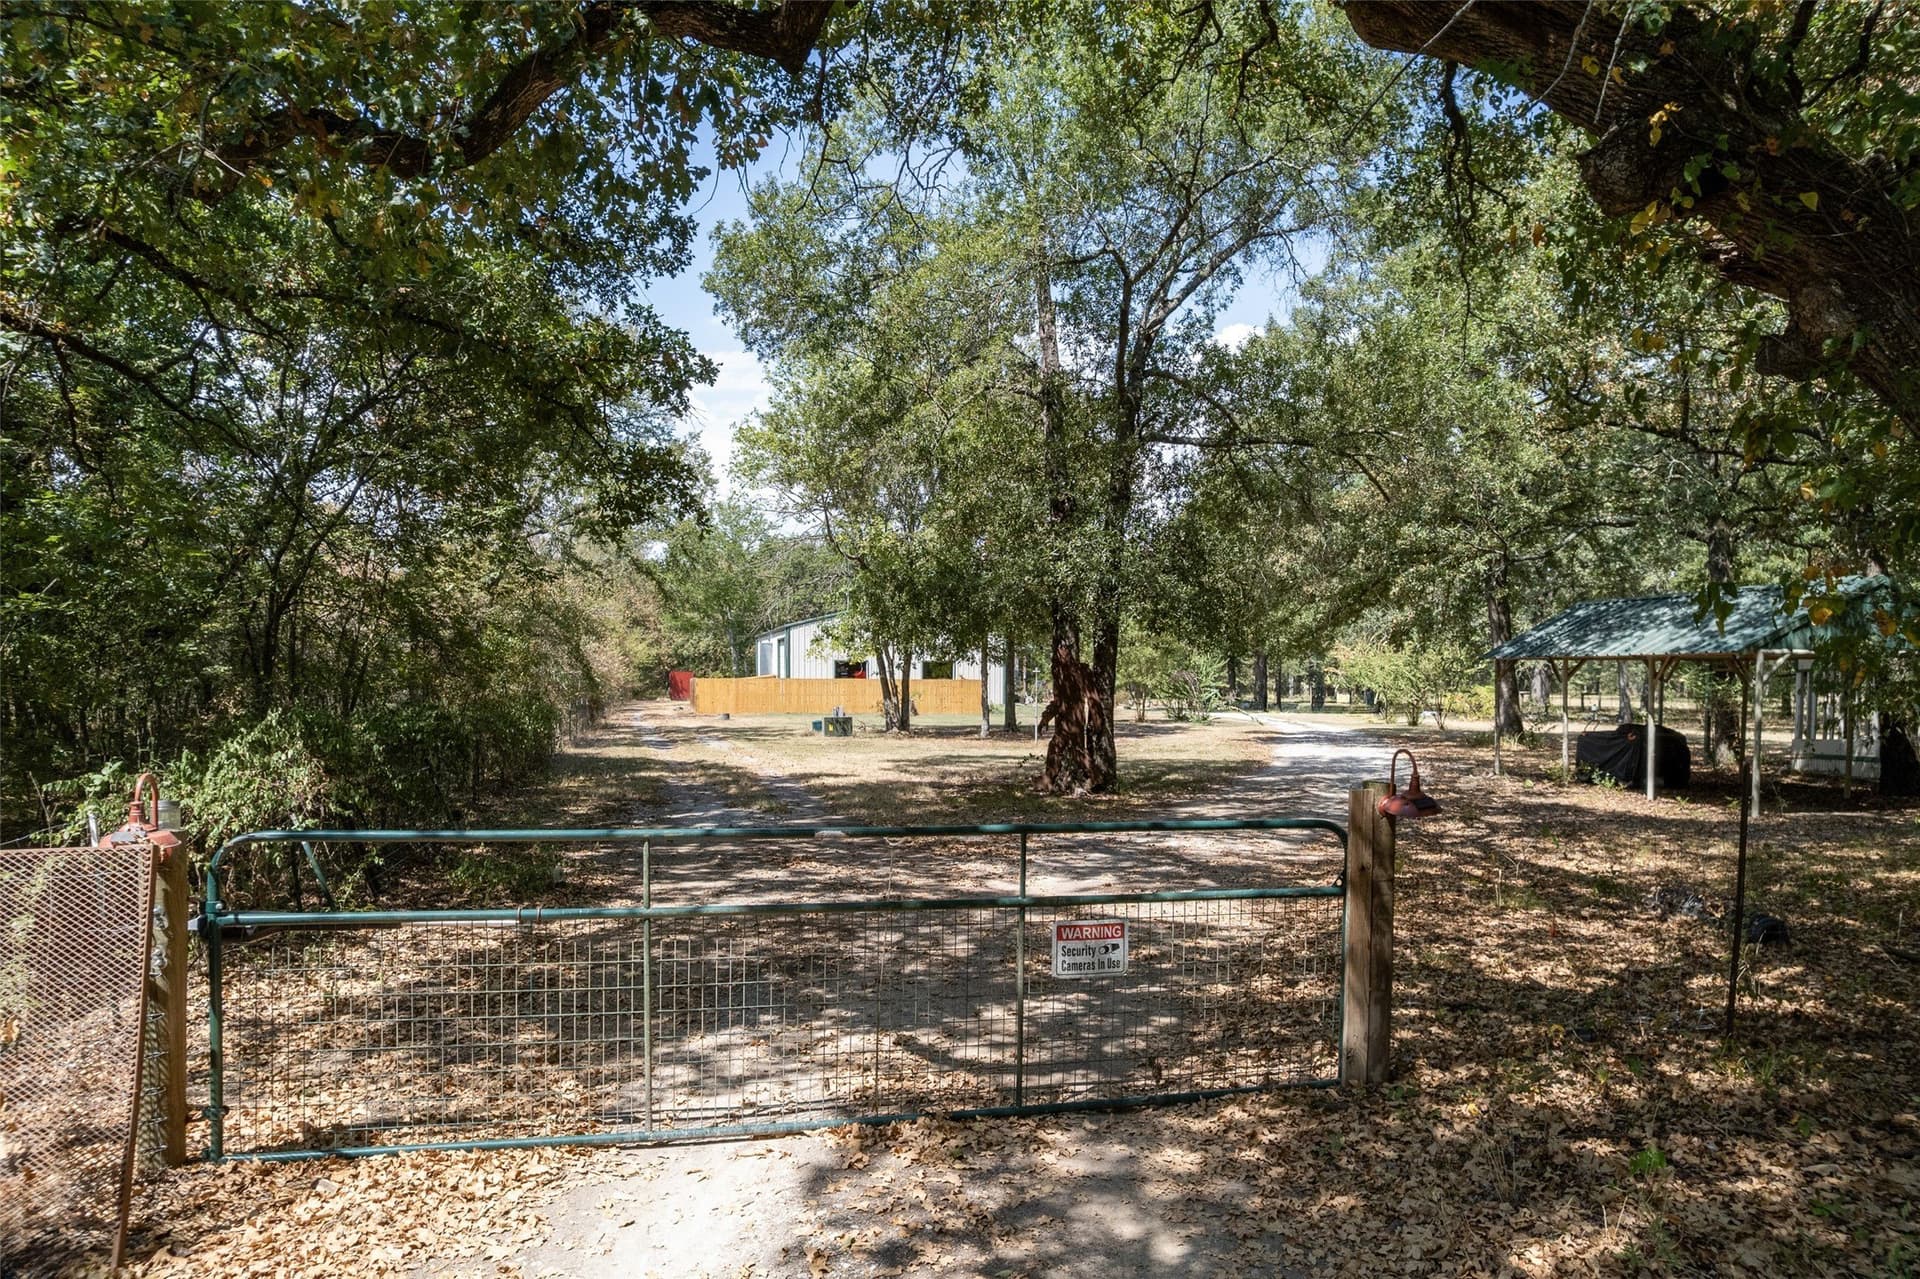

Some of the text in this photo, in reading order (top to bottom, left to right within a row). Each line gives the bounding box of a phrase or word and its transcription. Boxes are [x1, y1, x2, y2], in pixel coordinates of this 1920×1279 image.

[1061, 925, 1121, 940] WARNING
[1061, 944, 1096, 958] Security
[1061, 958, 1120, 972] Cameras In Use
